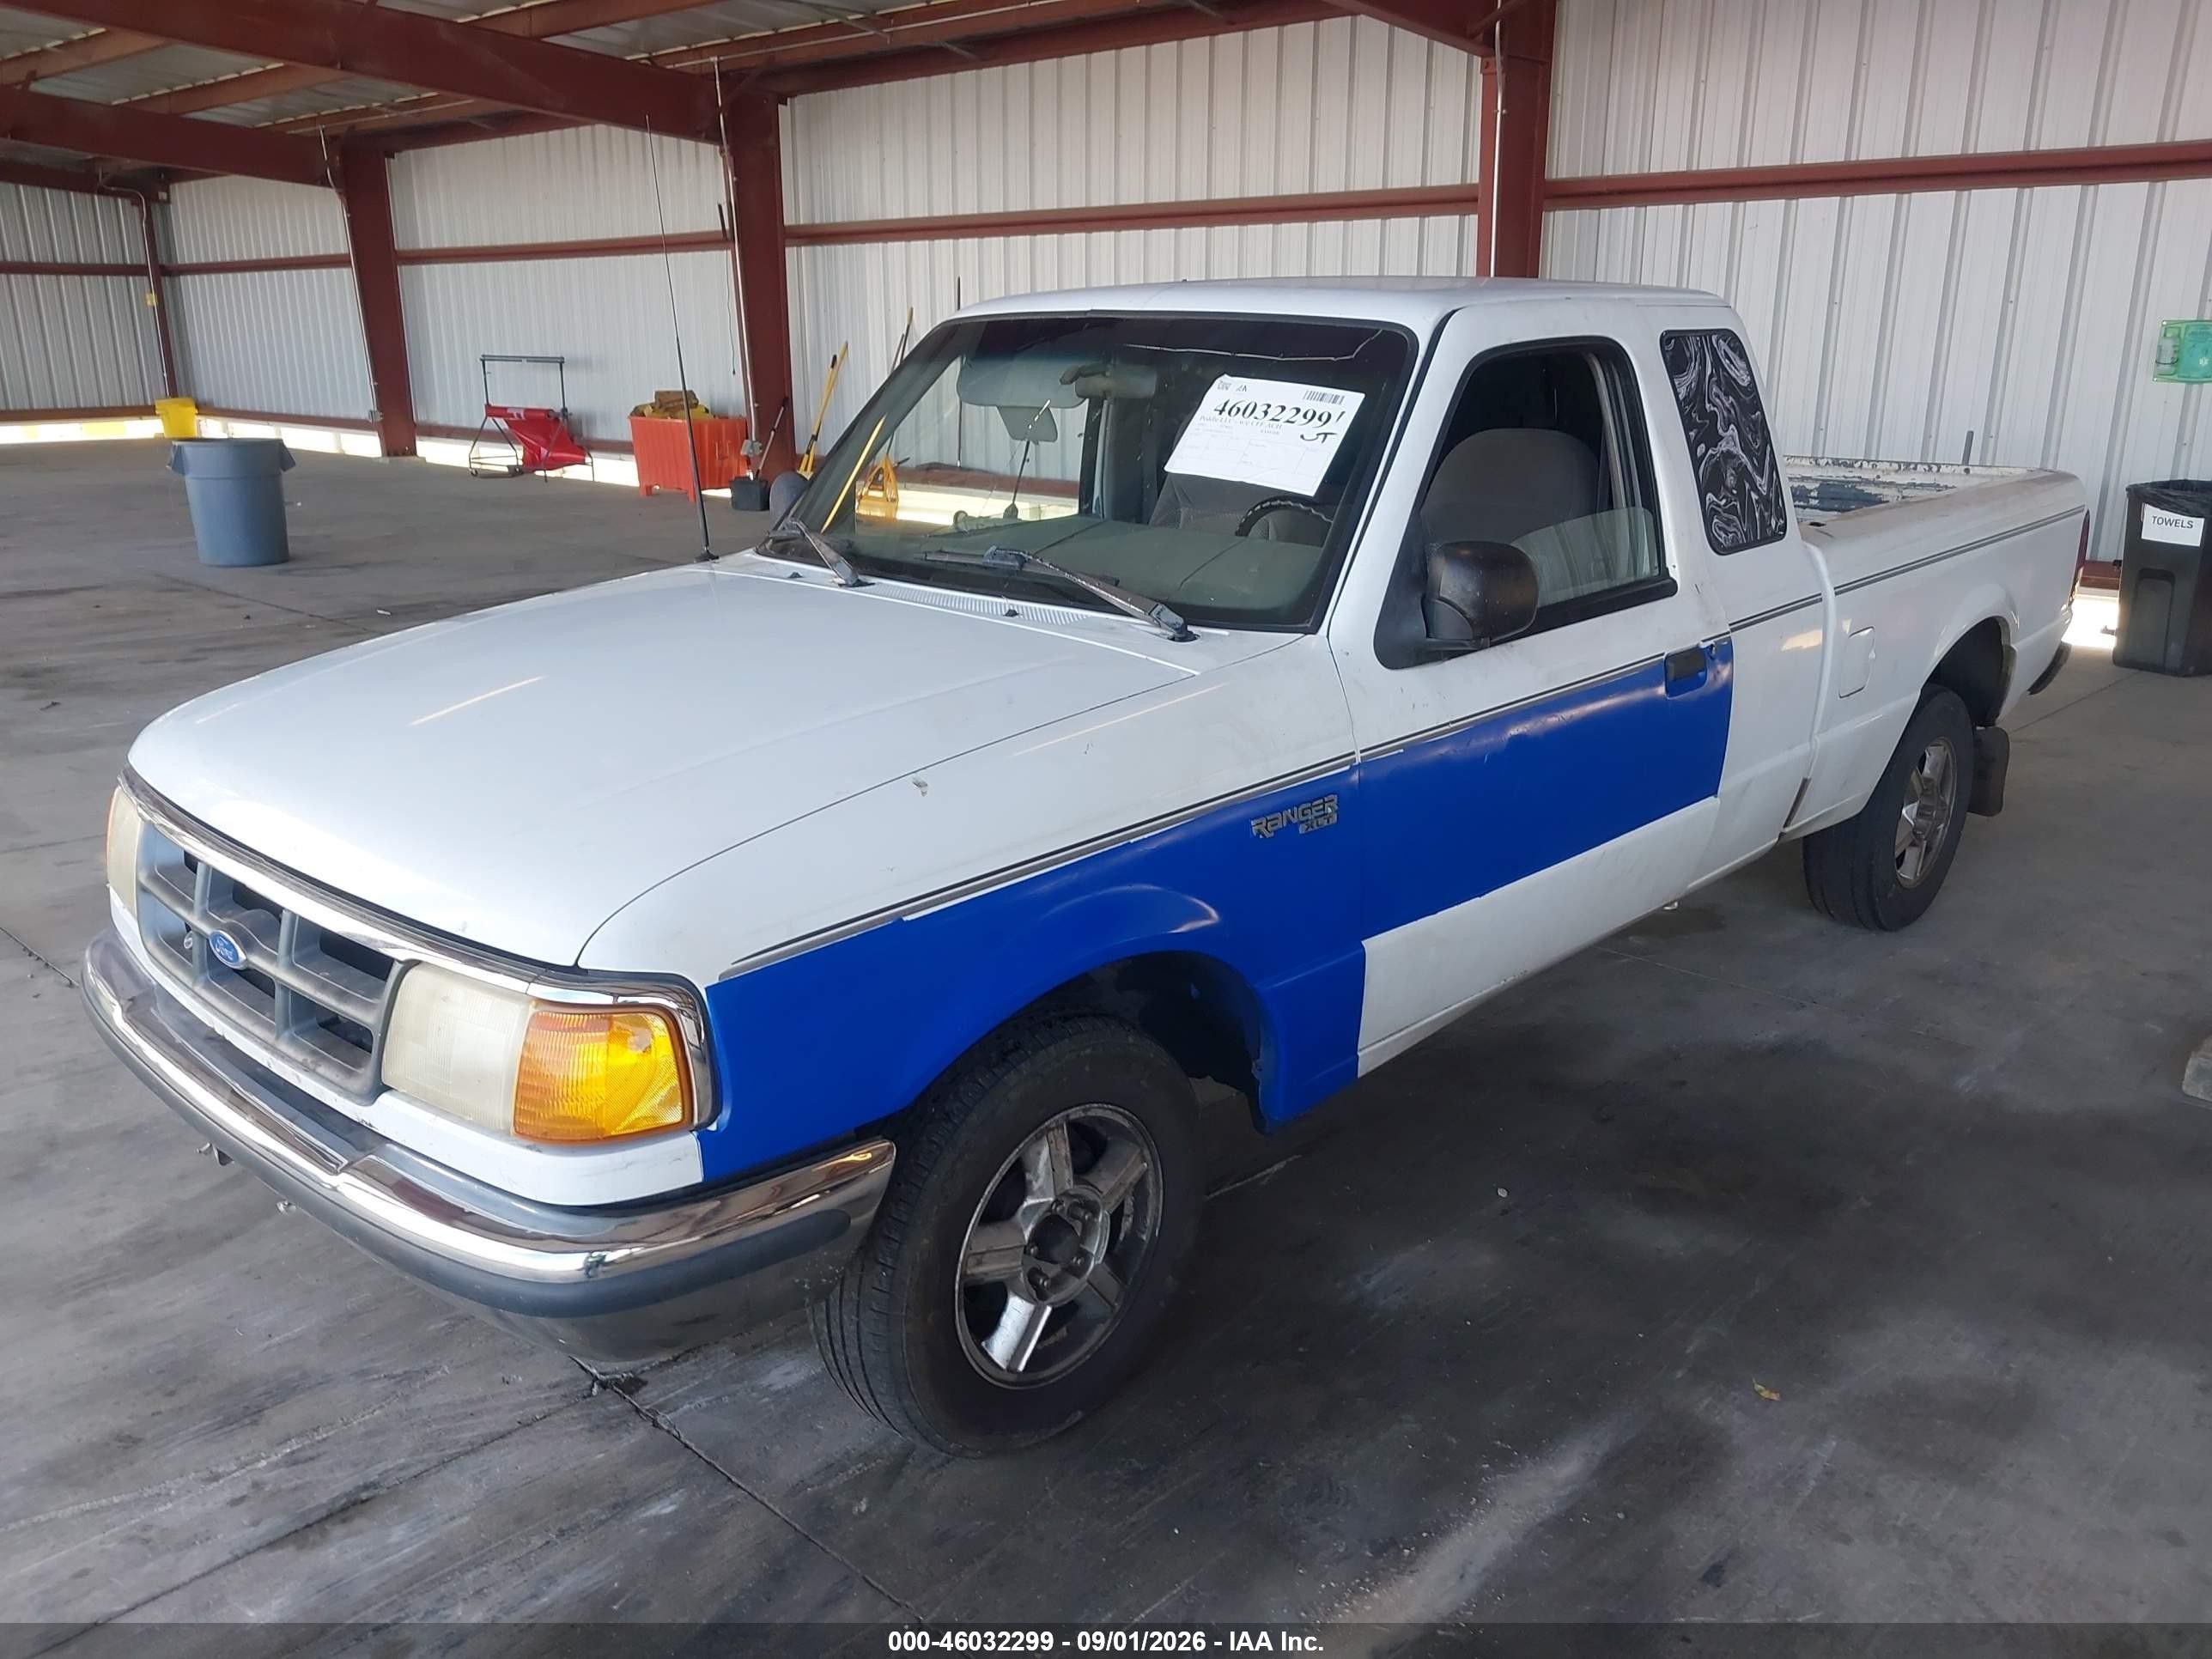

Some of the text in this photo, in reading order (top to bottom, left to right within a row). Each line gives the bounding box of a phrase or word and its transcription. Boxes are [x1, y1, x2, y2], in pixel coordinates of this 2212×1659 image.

[1213, 398, 1333, 428] 46032299
[2152, 515, 2194, 529] TOWELS
[1250, 794, 1338, 839] RANGER
